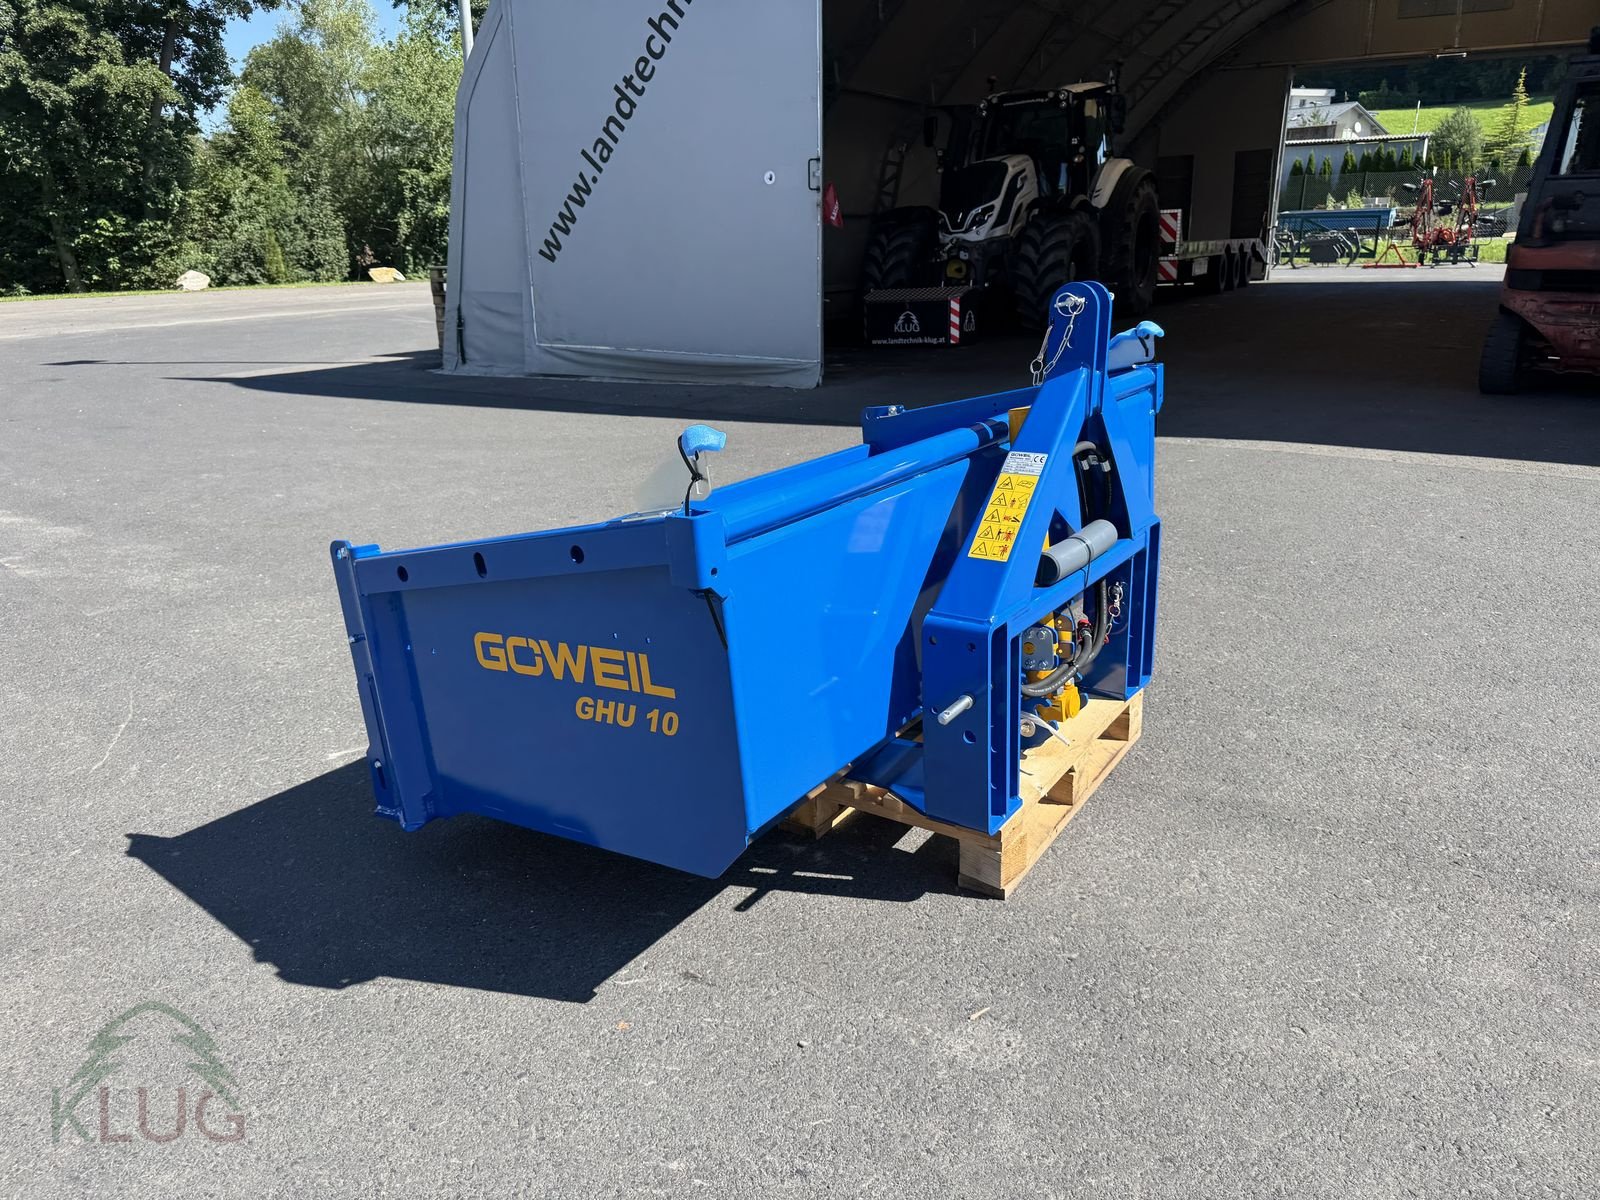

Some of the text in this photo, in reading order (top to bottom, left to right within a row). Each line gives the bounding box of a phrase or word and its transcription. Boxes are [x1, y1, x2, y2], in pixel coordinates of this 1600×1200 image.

[894, 323, 920, 332] KLUG
[872, 336, 945, 345] www.landtechnik-klug.at
[575, 696, 679, 736] GHU 10
